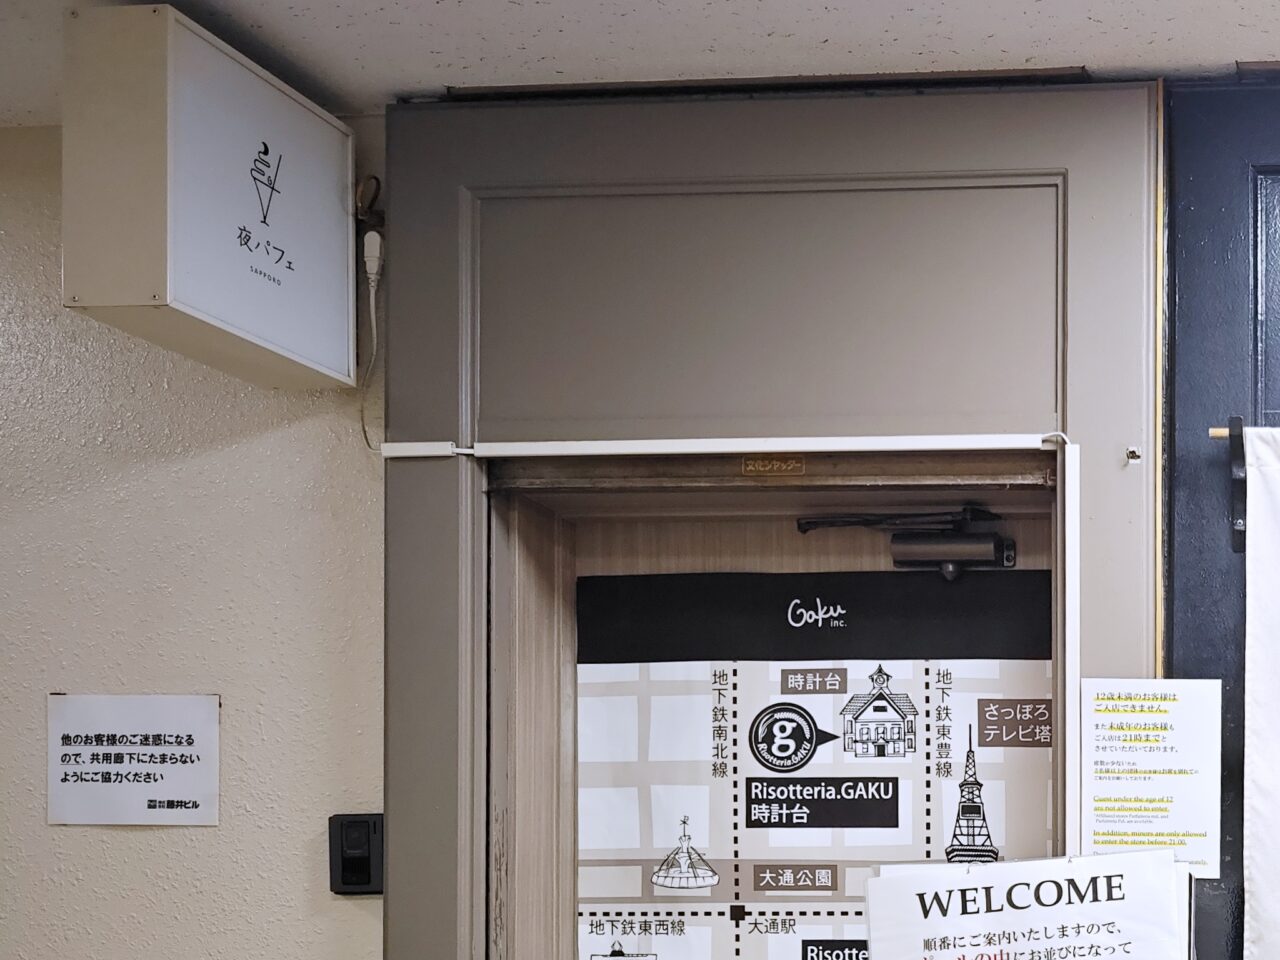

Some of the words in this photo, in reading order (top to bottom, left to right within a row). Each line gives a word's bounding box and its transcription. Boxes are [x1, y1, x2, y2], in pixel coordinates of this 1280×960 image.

[237, 225, 295, 272] 夜パフェ
[250, 265, 281, 286] SAPPORO
[787, 597, 846, 627] Gaku
[830, 619, 847, 627] inc.
[787, 672, 842, 691] 時計台
[984, 703, 1049, 721] さっぽろ
[711, 669, 729, 779] 地下鉄南北線
[935, 668, 953, 778] 地下鉄東豊線
[60, 733, 195, 746] 他のお客様のご迷惑になる
[984, 725, 1052, 742] テレビ塔
[60, 752, 201, 765] ので、共用廊下にたまらない
[757, 741, 811, 767] Risotteria.GAKU
[60, 771, 164, 783] ようにご協力ください
[751, 782, 893, 800] Risotteria.GAKU
[751, 803, 810, 824] 時計台
[759, 869, 832, 887] 大通公園
[916, 874, 1126, 919] WELCOME
[588, 919, 686, 936] 地下鉄東西線
[747, 918, 797, 935] 大通駅
[922, 921, 1122, 951] 順番にご案内いたしますので、
